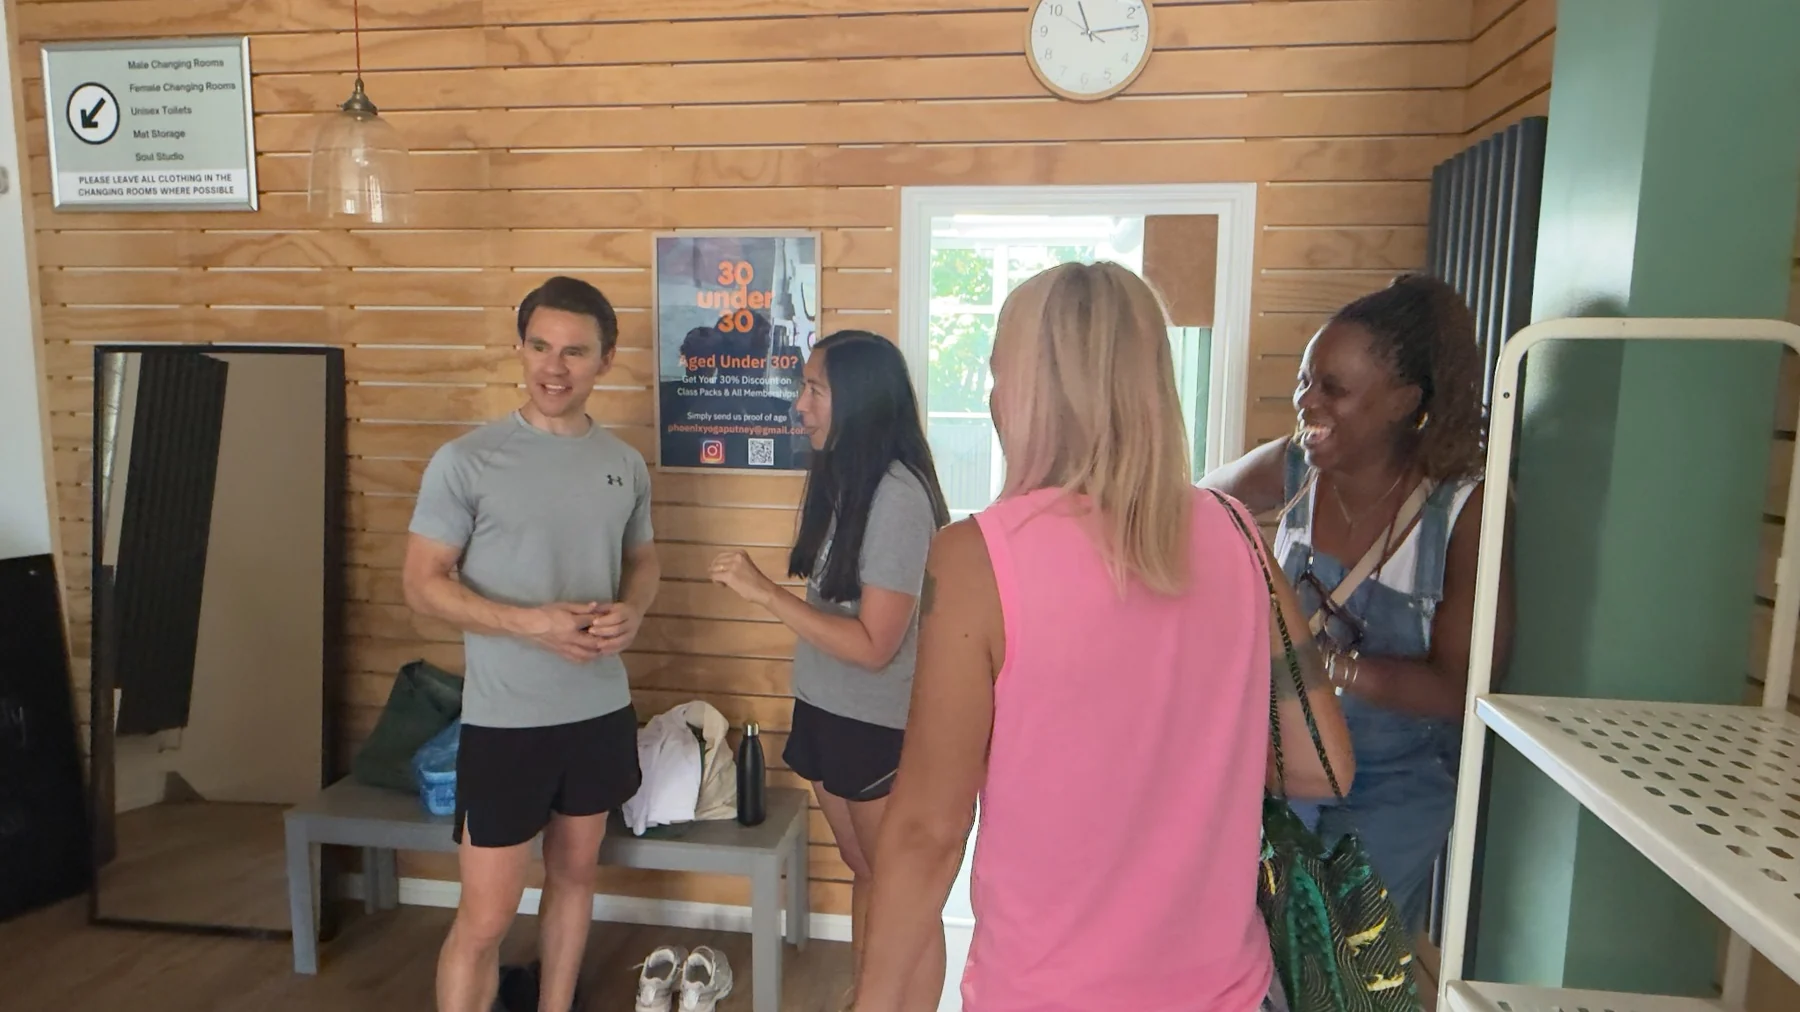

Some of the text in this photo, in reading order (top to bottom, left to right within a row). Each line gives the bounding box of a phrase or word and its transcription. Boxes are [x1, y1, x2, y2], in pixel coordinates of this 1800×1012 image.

[1049, 4, 1063, 17] 10
[1126, 6, 1136, 20] 2
[1040, 25, 1048, 38] 9
[1130, 28, 1139, 41] 3
[1044, 48, 1053, 60] 8
[1121, 52, 1129, 64] 4
[128, 58, 224, 70] Male Changing Rooms
[129, 81, 236, 93] Female Changing Rooms
[131, 105, 192, 116] Unisex Toilets
[133, 129, 186, 140] Mat Storage
[135, 151, 184, 162] Soul Studio
[78, 173, 232, 184] PLEASE LEAVE ALL CLOTHING IN THE
[78, 186, 234, 197] CHANGING ROOMS WHERE POSSIBLE
[717, 260, 754, 286] 30
[696, 284, 775, 309] under
[717, 308, 754, 333] 30
[679, 354, 799, 371] Aged Under 30?
[682, 375, 792, 385] Get Your 30% Discount on
[677, 387, 799, 399] Class Packs & All Memberships!
[687, 411, 787, 423] Simply send us proof of age
